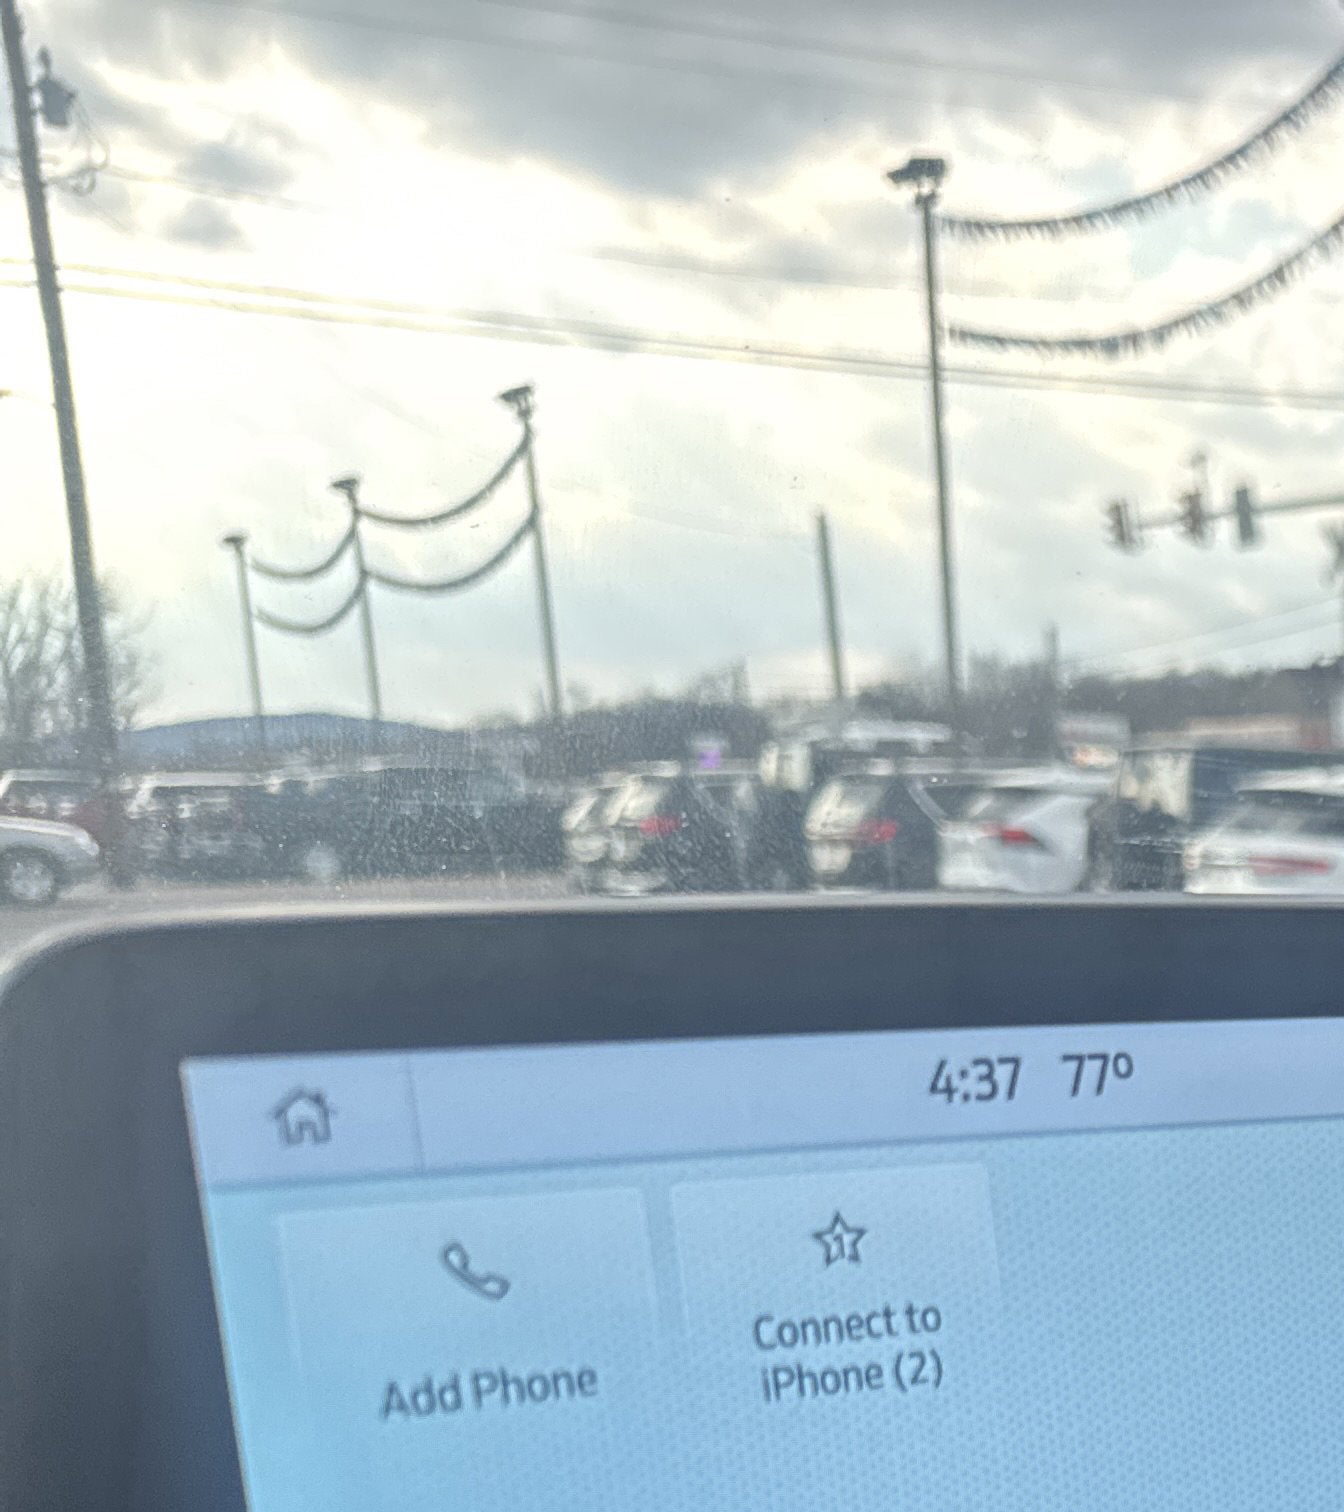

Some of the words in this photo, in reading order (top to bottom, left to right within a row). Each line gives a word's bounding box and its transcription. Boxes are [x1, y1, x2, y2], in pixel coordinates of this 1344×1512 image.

[929, 1056, 1022, 1102] 4:37
[754, 1302, 898, 1351] Connect
[905, 1302, 942, 1333] to
[381, 1373, 464, 1423] Add
[471, 1366, 599, 1411] Phone
[761, 1362, 885, 1404] iPhone
[894, 1348, 944, 1394] (2)
